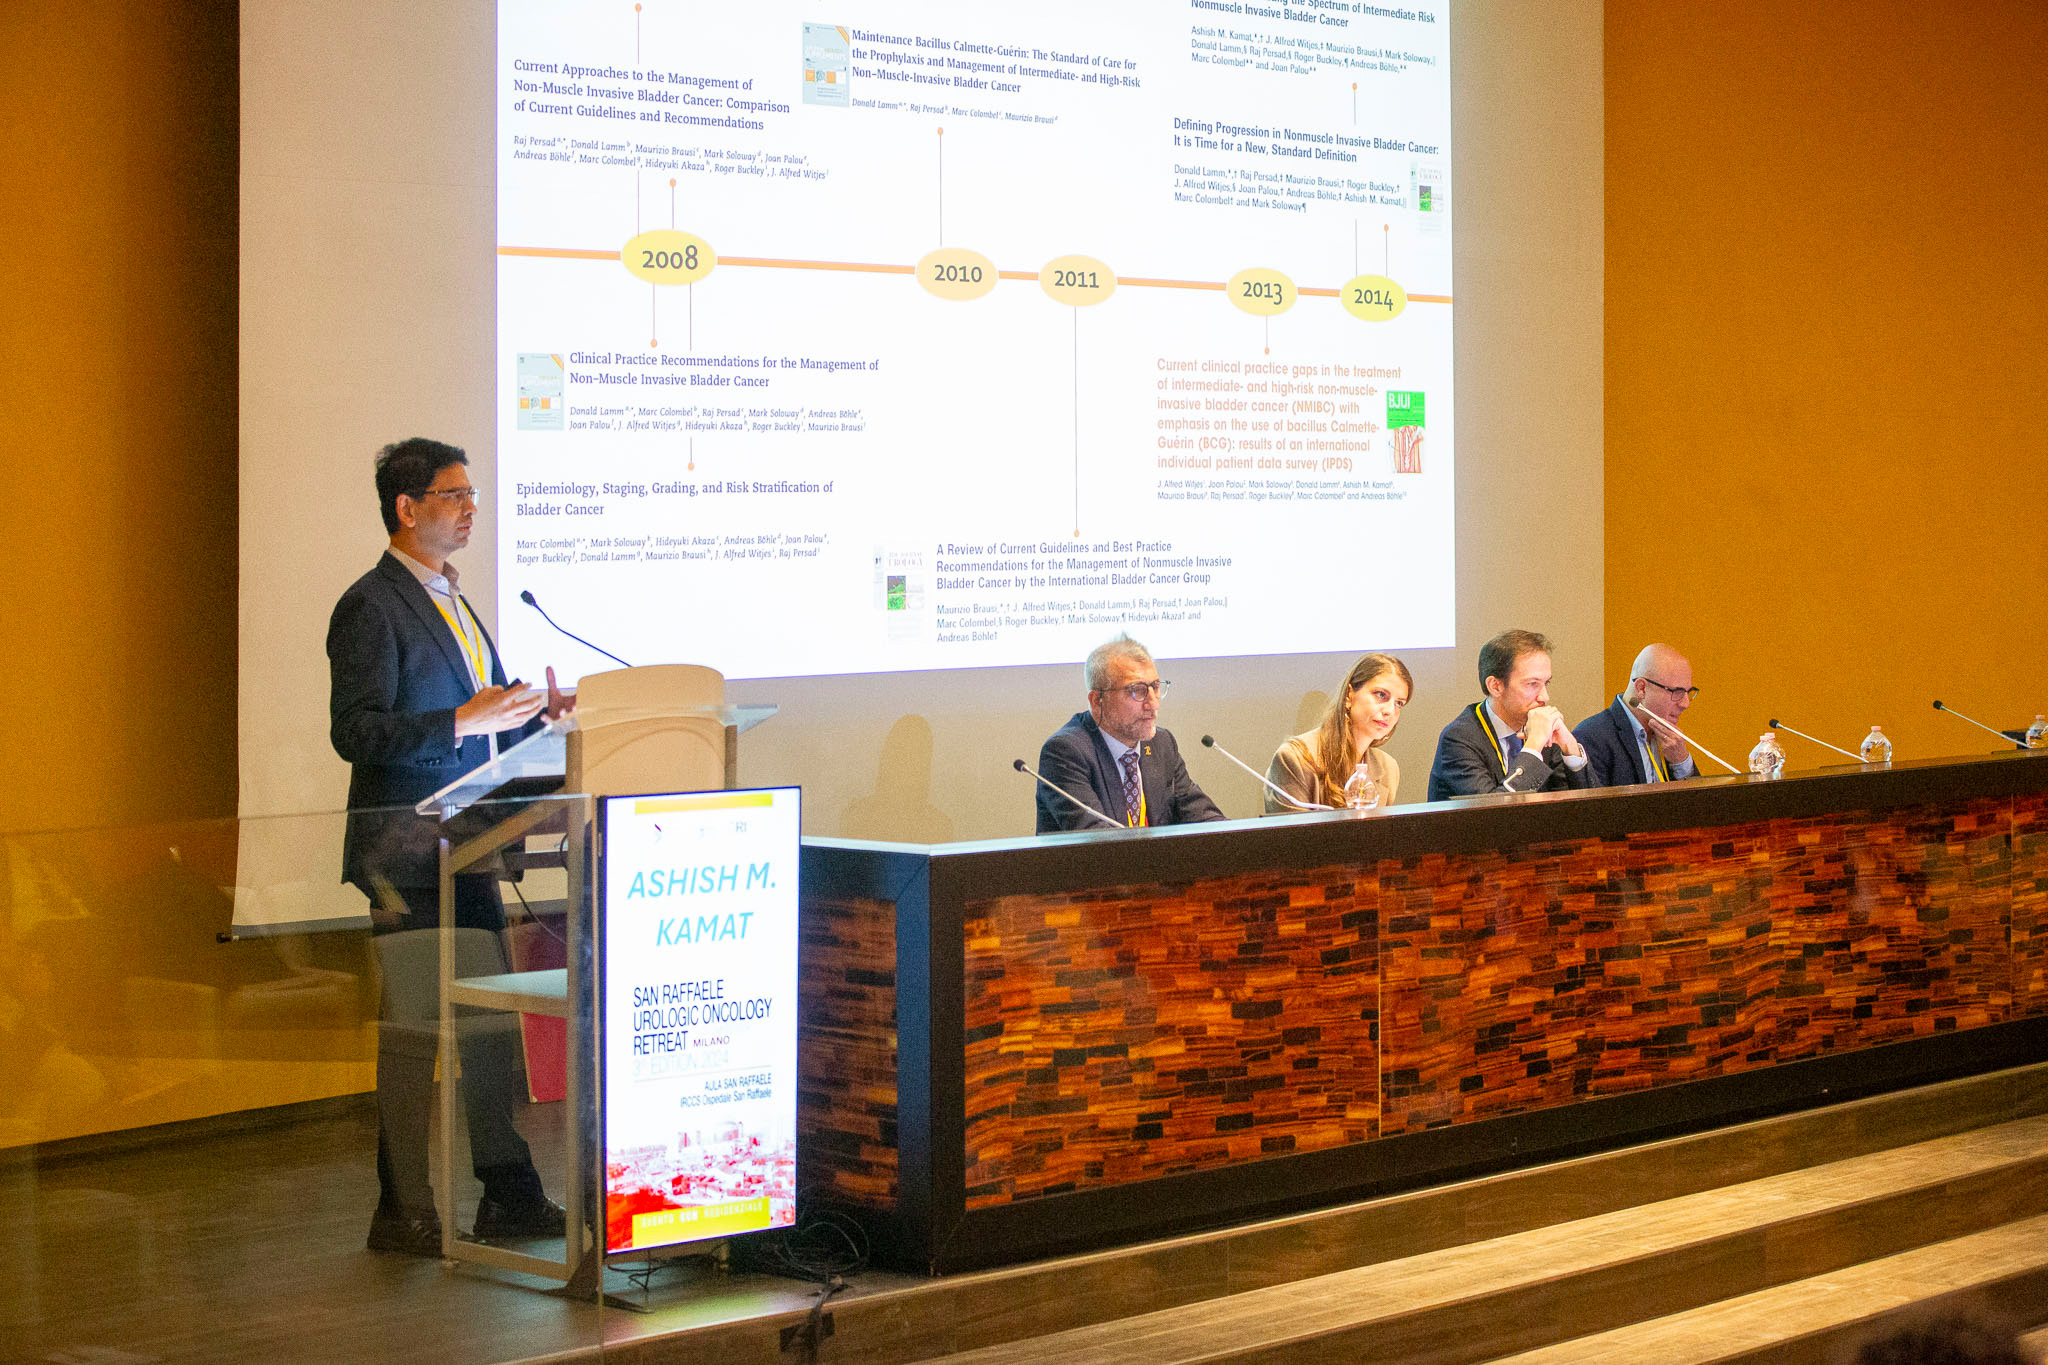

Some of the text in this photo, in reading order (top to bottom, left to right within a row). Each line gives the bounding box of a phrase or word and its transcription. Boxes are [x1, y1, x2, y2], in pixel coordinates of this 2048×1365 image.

[1191, 0, 1242, 14] Nonmuscle
[1245, 3, 1281, 19] Invasive
[1284, 8, 1317, 23] Bladder
[1319, 13, 1349, 28] Cancer
[1308, 0, 1349, 12] Spectrum
[1352, 2, 1361, 13] of
[1363, 3, 1416, 21] Intermediate
[1418, 11, 1435, 24] Risk
[852, 29, 1137, 70] Maintenance Bacillus Calmette-Guérin: The Standard of Care for
[514, 59, 753, 90] Current Approaches to the Management of
[852, 47, 868, 59] the
[870, 49, 925, 66] Prophylaxis
[927, 56, 944, 67] and
[947, 57, 1005, 74] Management
[1007, 64, 1017, 75] of
[1019, 65, 1079, 81] Intermediate-
[1081, 72, 1097, 83] and
[1100, 73, 1141, 88] High-Risk
[513, 79, 790, 114] Non-Muscle Invasive Bladder Cancer: Comparison
[953, 76, 988, 90] Bladder
[991, 80, 1021, 93] Cancer
[514, 99, 764, 130] of Current Guidelines and Recommendations
[1174, 117, 1439, 155] Defining Progression in Nonmuscle Invasive Bladder Cancer:
[1174, 134, 1357, 163] It is Time for a New, Standard Definition
[570, 139, 781, 164] Donald Maurizio Mark Joan
[513, 149, 801, 180] Andreas Marc Hideyuki Roger Alfred
[642, 245, 698, 270] 2008
[934, 264, 983, 283] 2010
[1054, 270, 1100, 289] 2011
[1243, 281, 1283, 306] 2013
[1354, 289, 1394, 312] 2014
[570, 351, 879, 373] Clinical Practice Recommendations for the Management of
[1157, 358, 1401, 379] Current clinical practice gaps in the treatment
[641, 373, 687, 386] Invasive
[690, 374, 731, 386] Bladder
[733, 375, 770, 387] Cancer
[1157, 377, 1378, 397] of intermediate- and high-risk non-muscle-
[1157, 397, 1360, 417] invasive bladder cancer (NMIBC) with
[1388, 393, 1411, 409] BJUI
[516, 480, 834, 499] Epidemiology, Staging, Grading, and Risk Stratification of
[936, 540, 1172, 555] A Review of Current Guidelines and Best Practice
[936, 559, 1028, 572] Recommendations
[1031, 559, 1045, 570] for
[1048, 558, 1064, 570] the
[1066, 558, 1128, 572] Management
[1131, 557, 1140, 568] of
[1143, 556, 1194, 568] Nonmuscle
[1196, 555, 1232, 567] Invasive
[627, 862, 776, 900] ASHISH M.
[656, 911, 754, 947] KAMAT
[633, 979, 724, 1008] SAN RAFFAELE
[633, 997, 772, 1032] UROLOGIC ONCOLOGY
[634, 1030, 730, 1056] RETREAT MILANO
[704, 1072, 772, 1091] AULA SAN RAFFAELE
